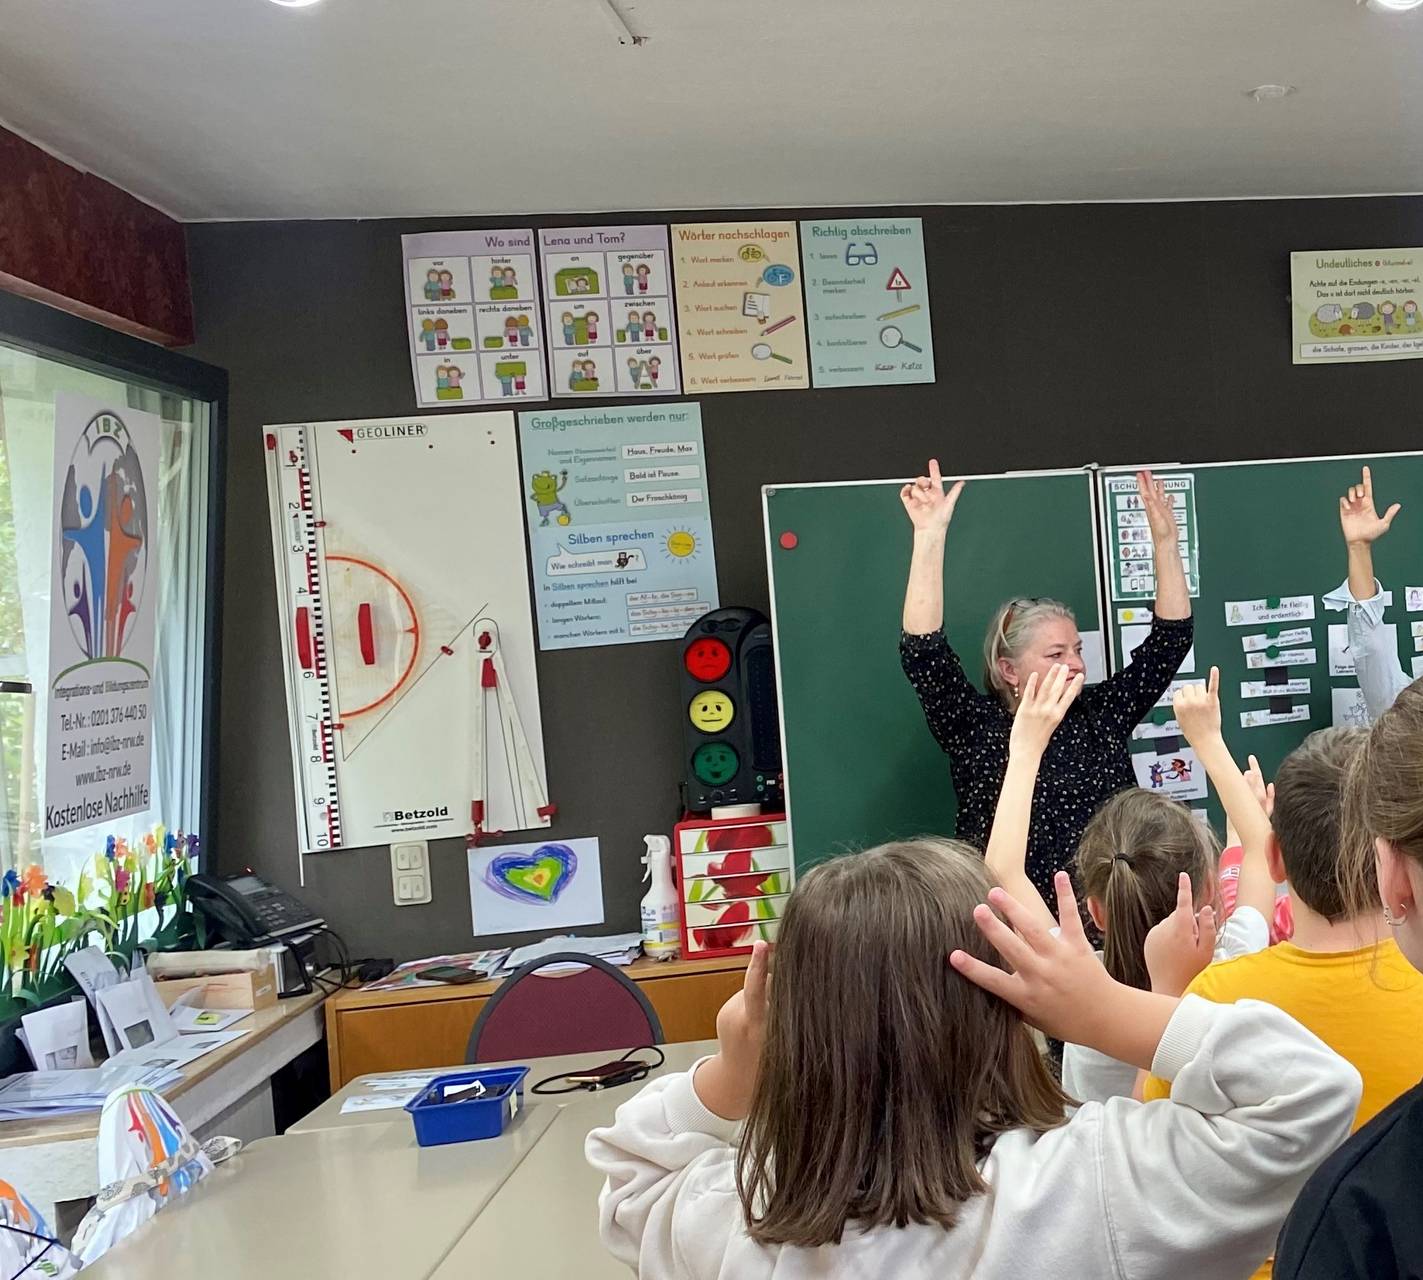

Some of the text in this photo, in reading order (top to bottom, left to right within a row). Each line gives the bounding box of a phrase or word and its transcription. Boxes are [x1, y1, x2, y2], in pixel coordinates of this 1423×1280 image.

[544, 232, 625, 245] Lena und Tom?
[679, 229, 790, 241] Wörter nachschlagen
[812, 226, 911, 240] Richtig abschreiben
[485, 236, 530, 247] Wo sind
[1316, 258, 1372, 269] Undeutliches
[95, 418, 123, 438] IBZ
[531, 414, 623, 431] Großgeschrieben
[627, 412, 665, 423] werden
[1114, 481, 1186, 490] SCHUNUNG
[568, 531, 654, 545] Silben sprechen
[45, 784, 149, 831] Kostenlose Nachhilfe
[394, 806, 448, 820] Betzold
